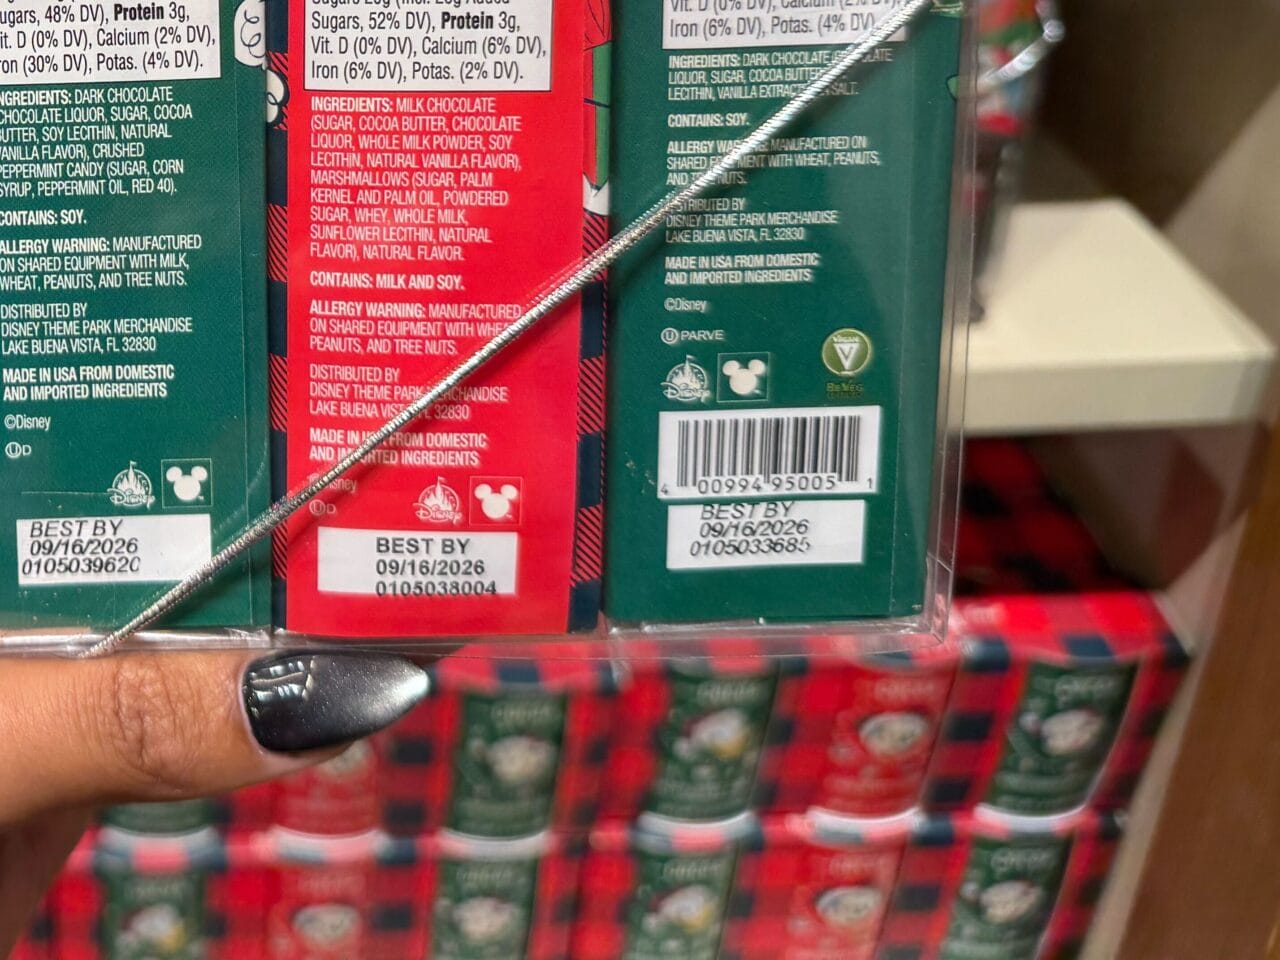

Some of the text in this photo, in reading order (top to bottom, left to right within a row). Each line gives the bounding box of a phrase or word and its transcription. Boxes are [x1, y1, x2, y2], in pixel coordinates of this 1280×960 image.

[75, 89, 105, 104] DARK
[107, 87, 173, 102] CHOCOLATE
[311, 97, 495, 113] INGREDIENTS: MILK CHOCOLATE
[667, 112, 750, 128] CONTAINS: SOY.
[60, 210, 87, 225] SOY.
[52, 238, 110, 254] WARNING:
[113, 235, 201, 251] MANUFACTURED
[680, 329, 724, 341] PARVE
[698, 476, 762, 494] 00994
[772, 475, 836, 491] 95005
[700, 501, 794, 520] BEST BY
[30, 519, 123, 538] BEST BY
[700, 520, 809, 538] 09/16/2026
[30, 539, 138, 556] 09/16/2026
[376, 537, 471, 554] BEST BY
[376, 559, 484, 576] 09/16/2026
[376, 580, 496, 597] 0105038004
